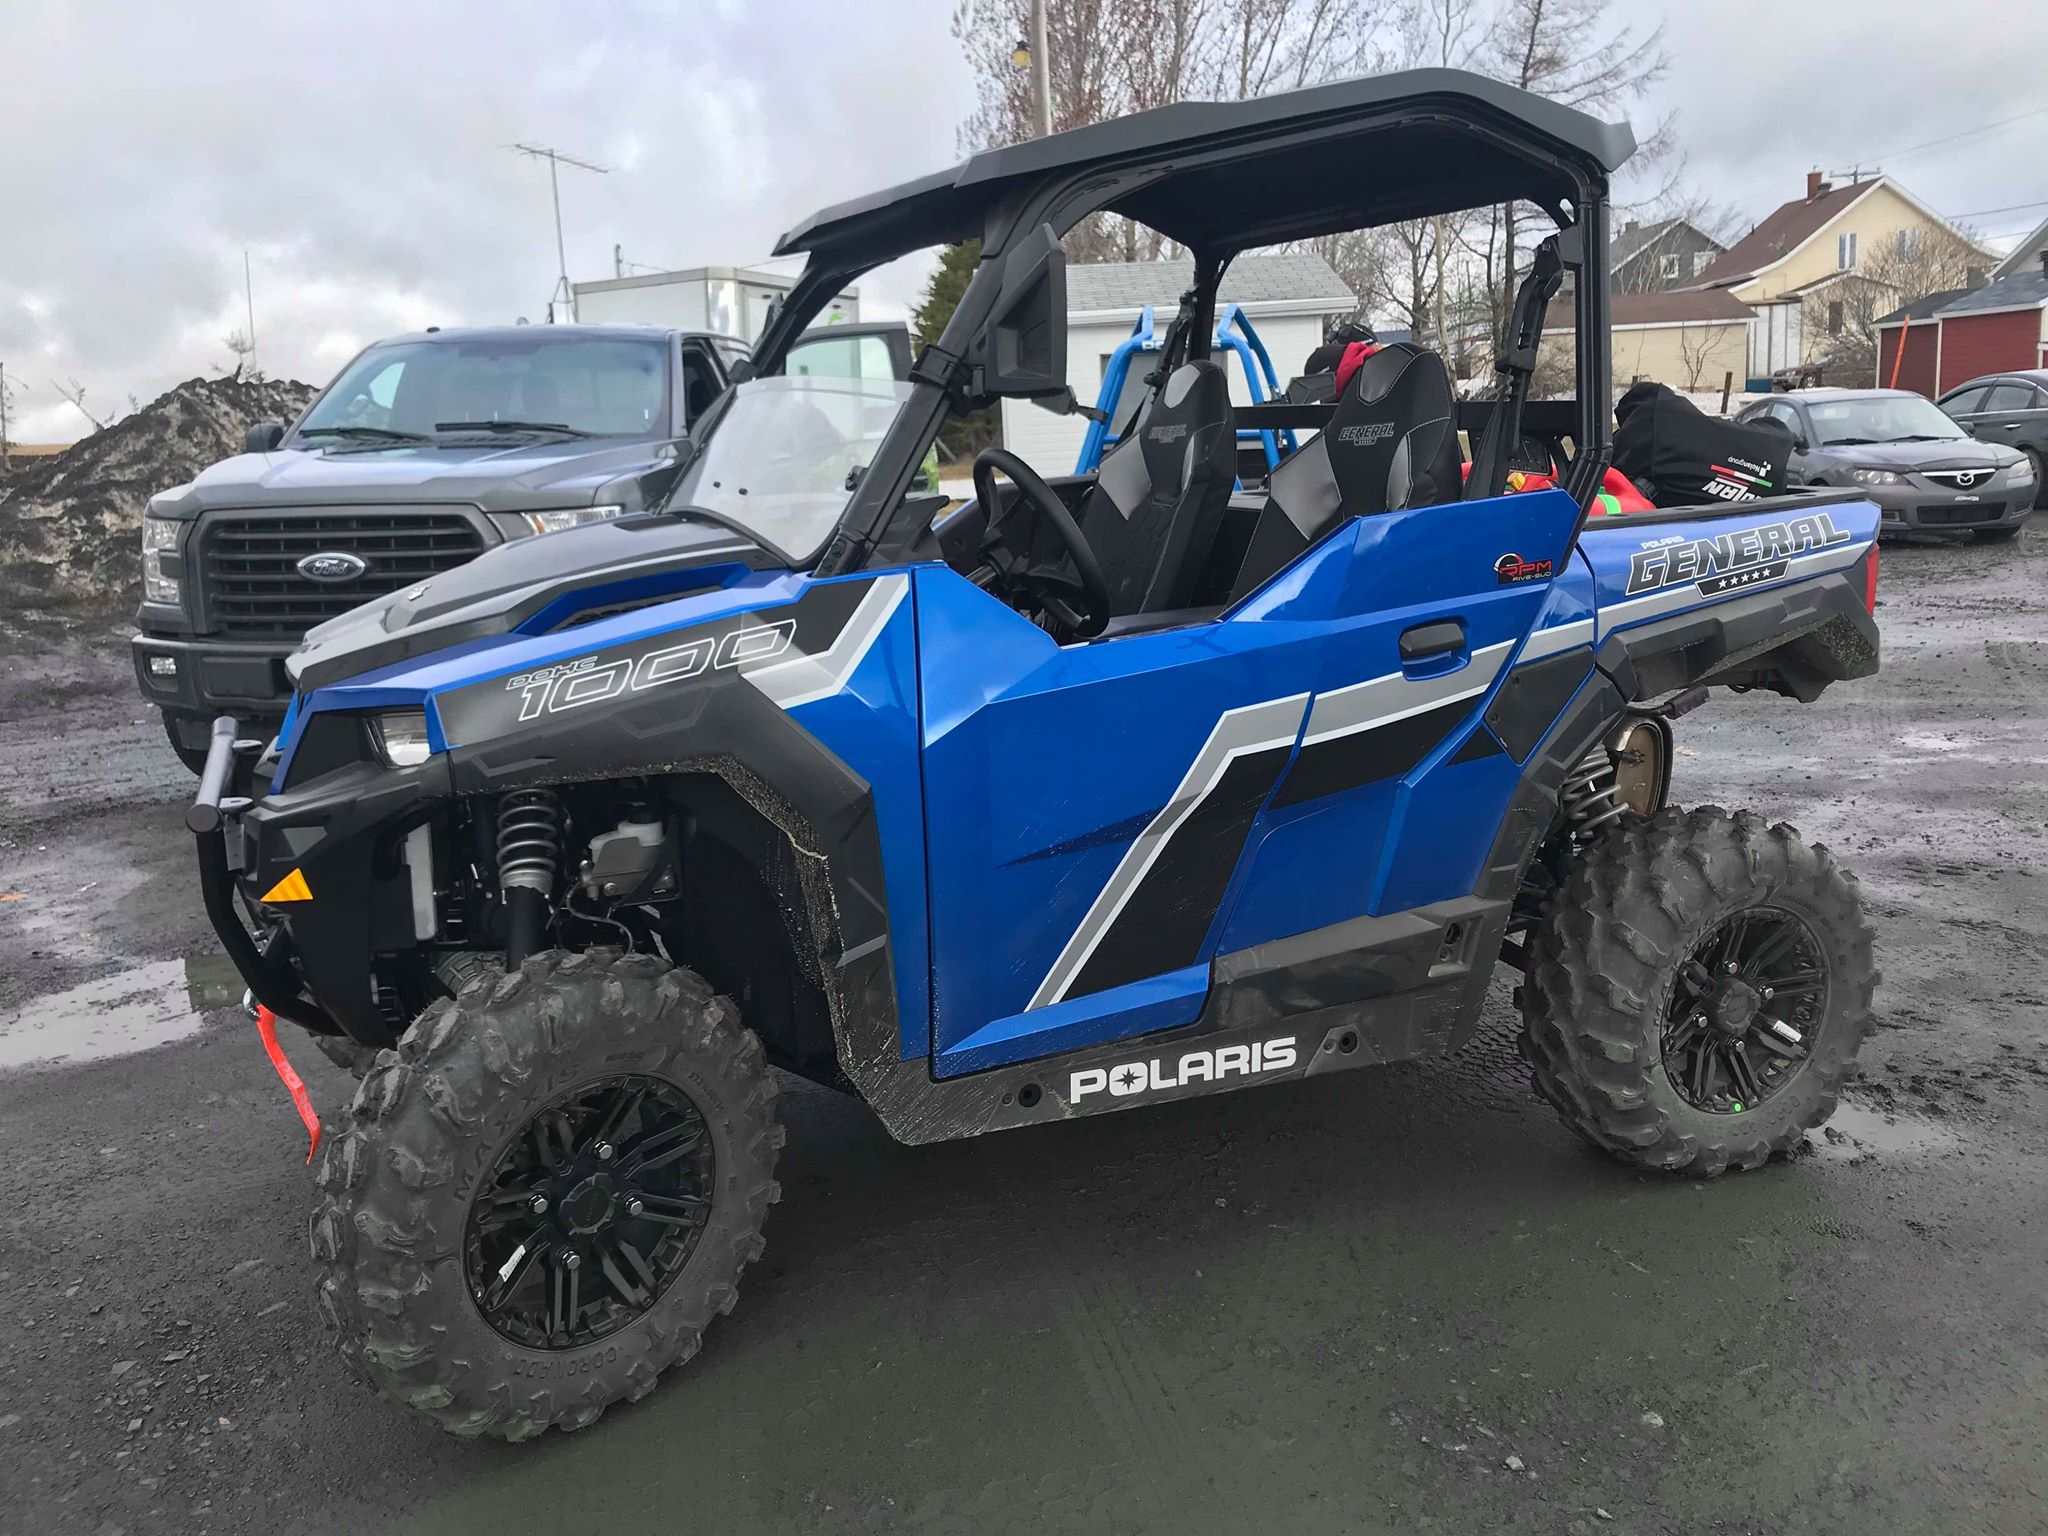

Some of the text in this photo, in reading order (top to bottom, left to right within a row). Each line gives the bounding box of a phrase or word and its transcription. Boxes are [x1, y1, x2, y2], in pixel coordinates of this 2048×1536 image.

[1338, 422, 1395, 441] GENERAL
[1625, 513, 1851, 597] GENERAL
[1640, 535, 1686, 550] POLARIS
[312, 558, 349, 576] Ford
[1498, 559, 1552, 577] RPM
[1512, 571, 1552, 582] RIVE-SUD
[505, 655, 599, 690] DOHC
[518, 618, 797, 721] 1000
[1070, 1036, 1297, 1105] POLARIS
[454, 1063, 580, 1202] MAXXIS
[512, 1346, 617, 1381] CORONADO
